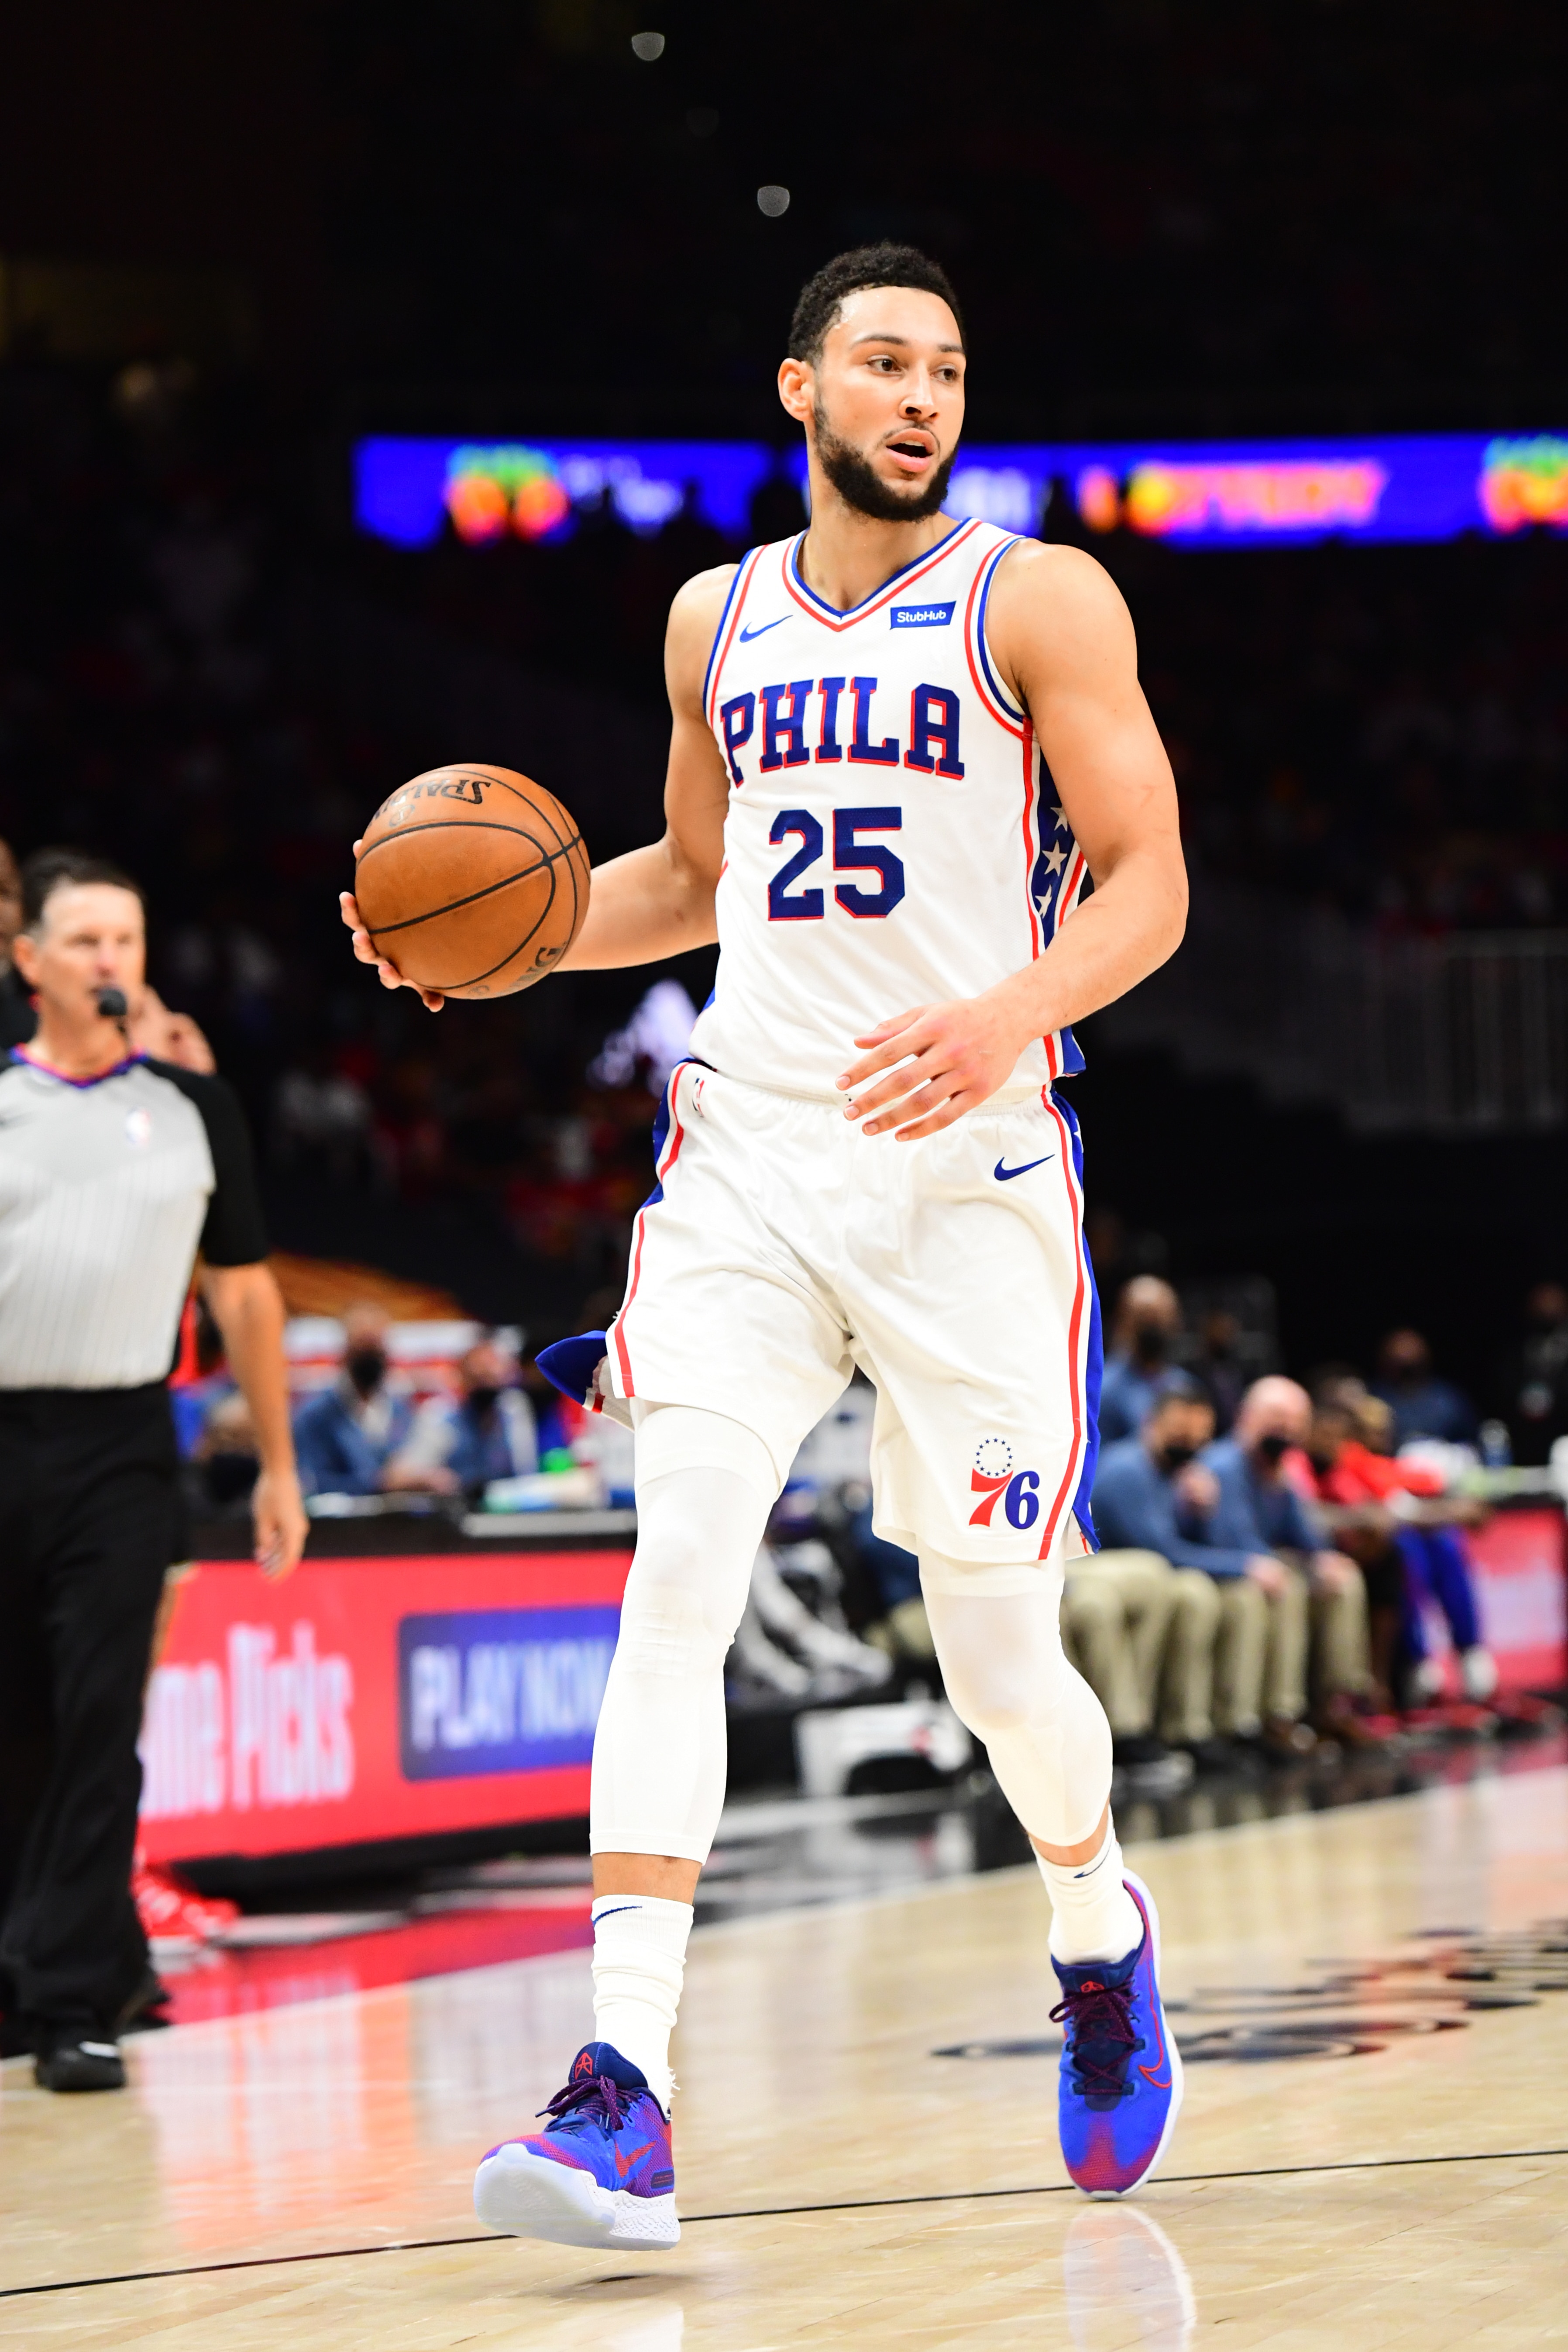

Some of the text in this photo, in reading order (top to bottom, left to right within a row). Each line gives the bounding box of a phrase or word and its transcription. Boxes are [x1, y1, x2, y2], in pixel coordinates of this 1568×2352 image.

[897, 610, 947, 623] StubHub
[720, 676, 965, 789] PHILA
[768, 806, 905, 921] 25
[969, 1467, 1040, 1530] 76
[409, 1641, 516, 1752] PLAY
